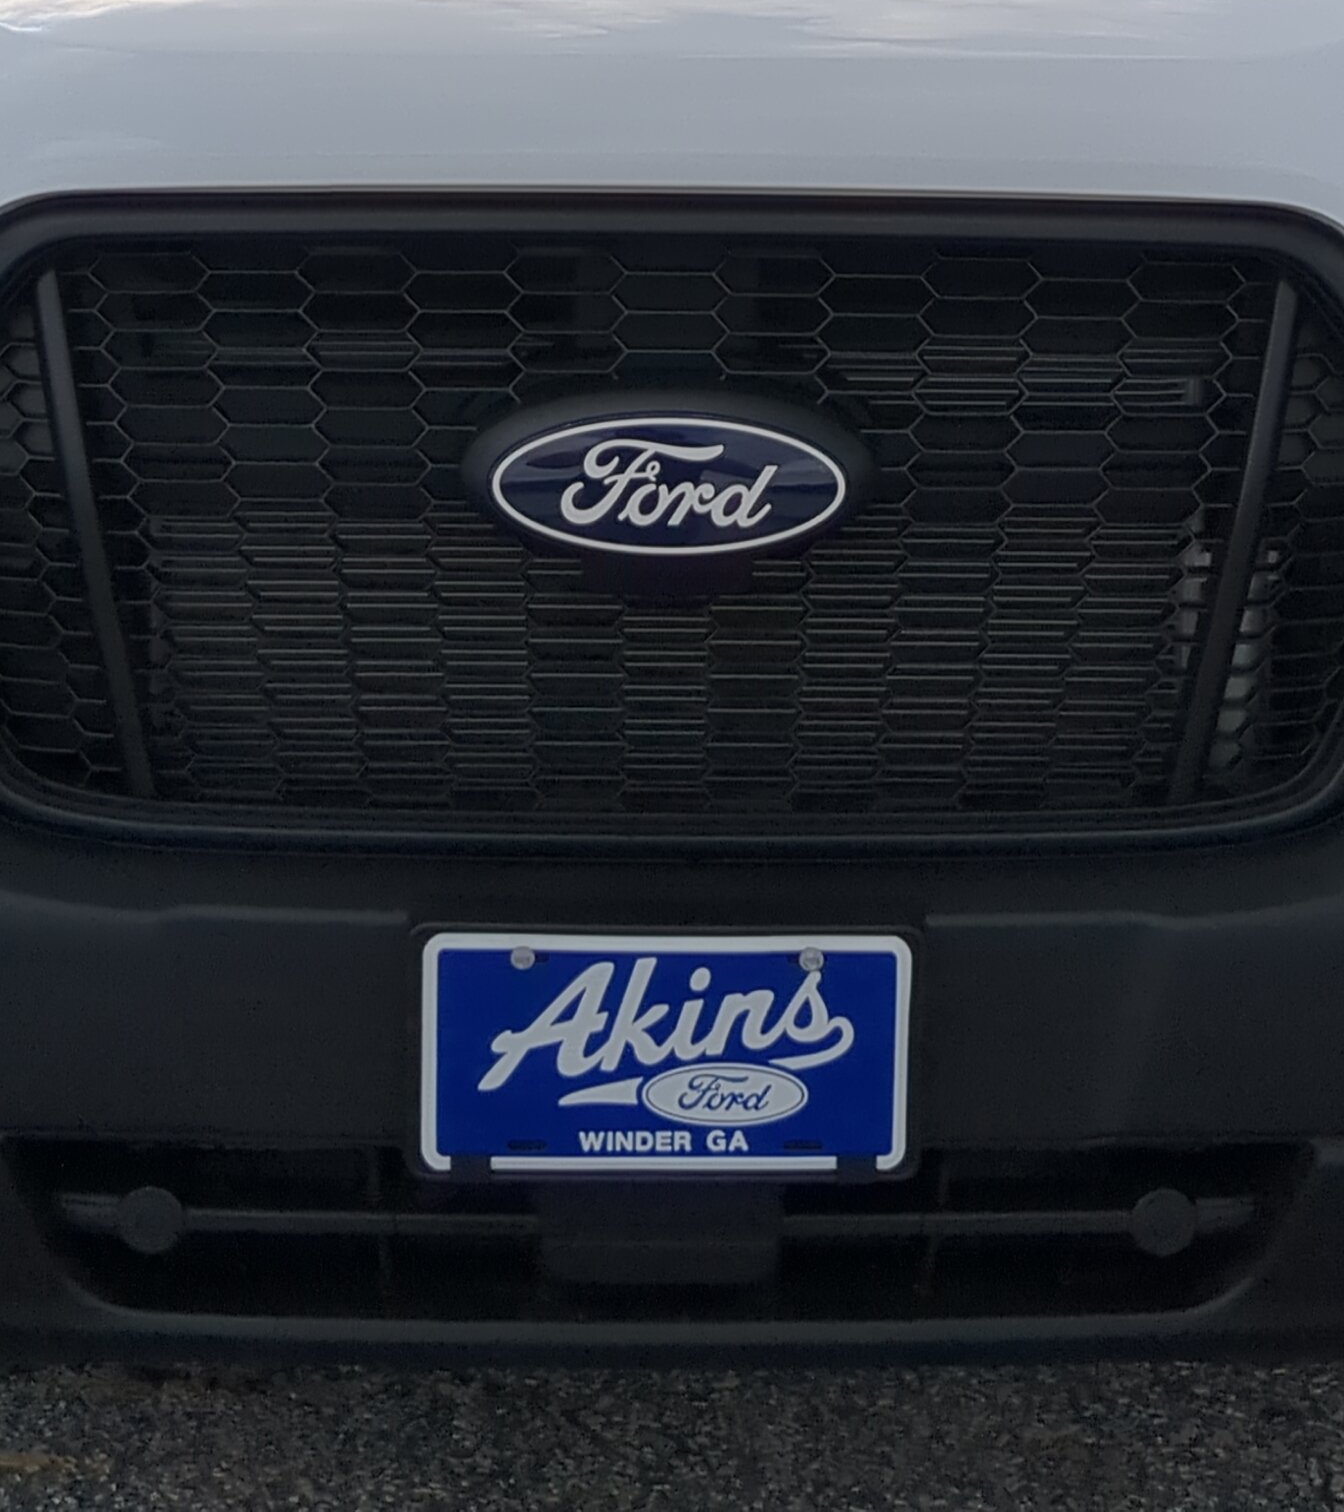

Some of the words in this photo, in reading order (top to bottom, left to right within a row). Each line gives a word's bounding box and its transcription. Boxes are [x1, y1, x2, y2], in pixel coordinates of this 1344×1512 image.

[560, 438, 778, 528] Ford
[476, 956, 856, 1093] Akins
[677, 1073, 770, 1113] Ford
[578, 1130, 692, 1153] WINDER
[706, 1130, 749, 1153] GA
